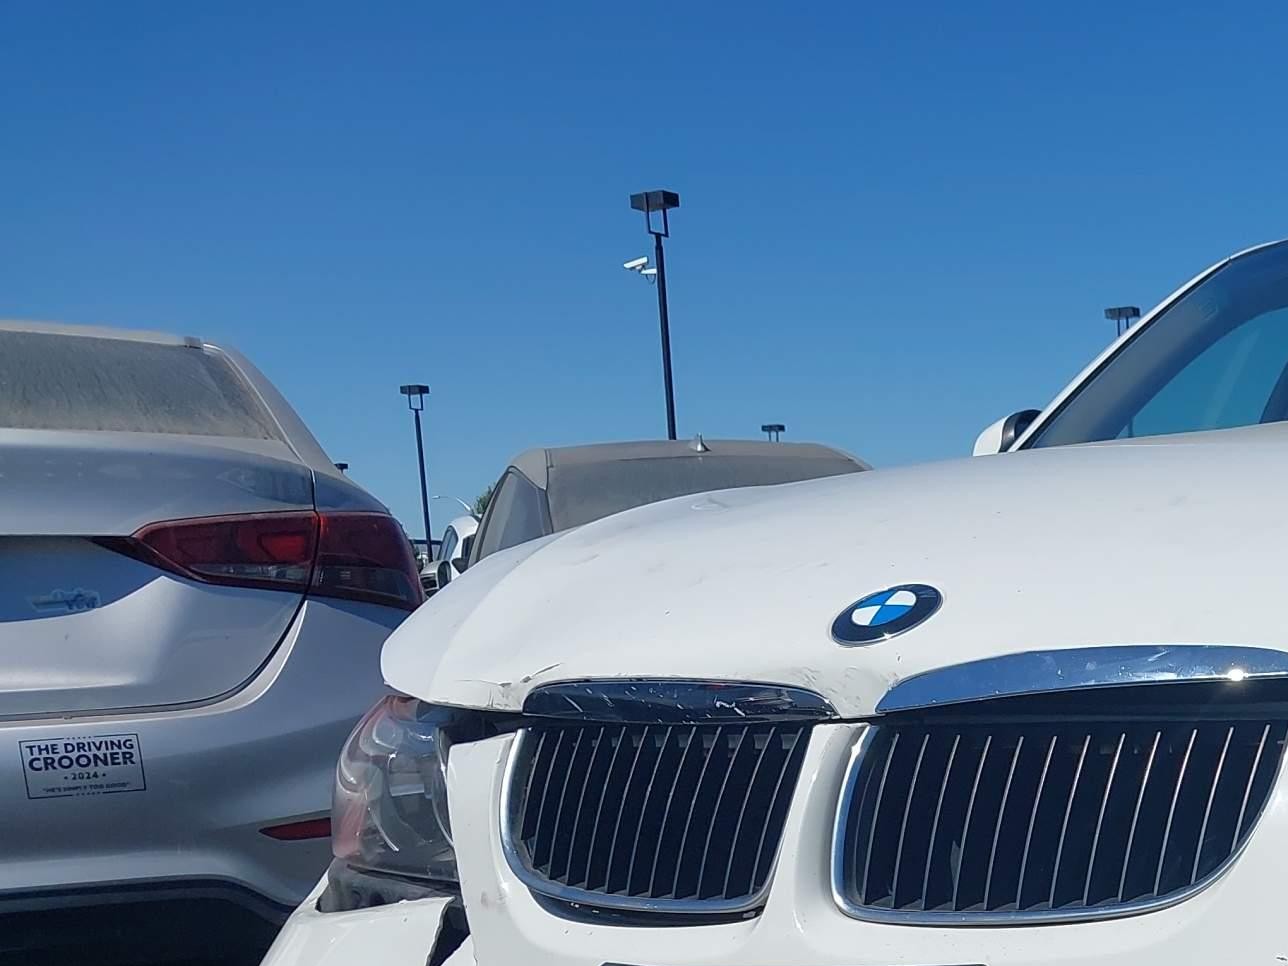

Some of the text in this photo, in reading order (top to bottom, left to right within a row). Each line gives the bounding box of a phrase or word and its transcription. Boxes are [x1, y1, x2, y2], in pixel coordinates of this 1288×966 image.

[25, 739, 134, 756] THE DRIVING
[28, 751, 136, 771] CROONER
[71, 771, 99, 780] 2024
